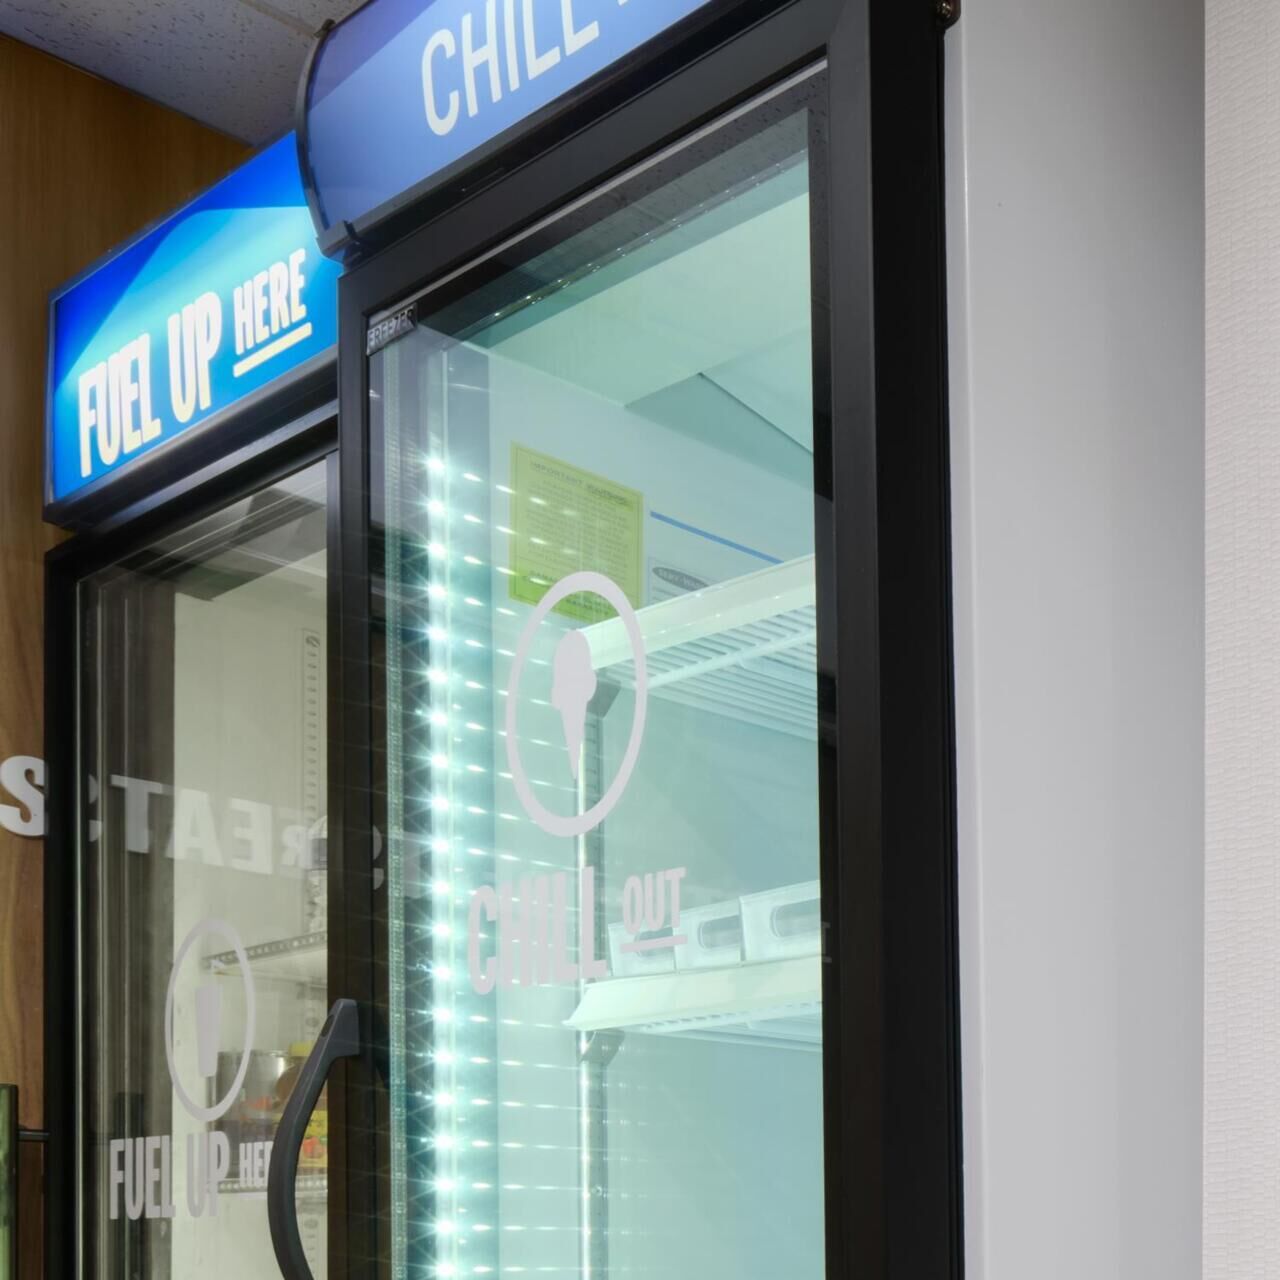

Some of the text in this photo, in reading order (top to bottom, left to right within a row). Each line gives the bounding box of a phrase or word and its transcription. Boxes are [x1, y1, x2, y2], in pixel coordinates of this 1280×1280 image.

[421, 0, 599, 136] CHILL
[79, 249, 306, 478] FUEL UP HERE
[468, 866, 687, 995] CHILL OUT
[110, 1131, 274, 1220] FUEL UP HE
